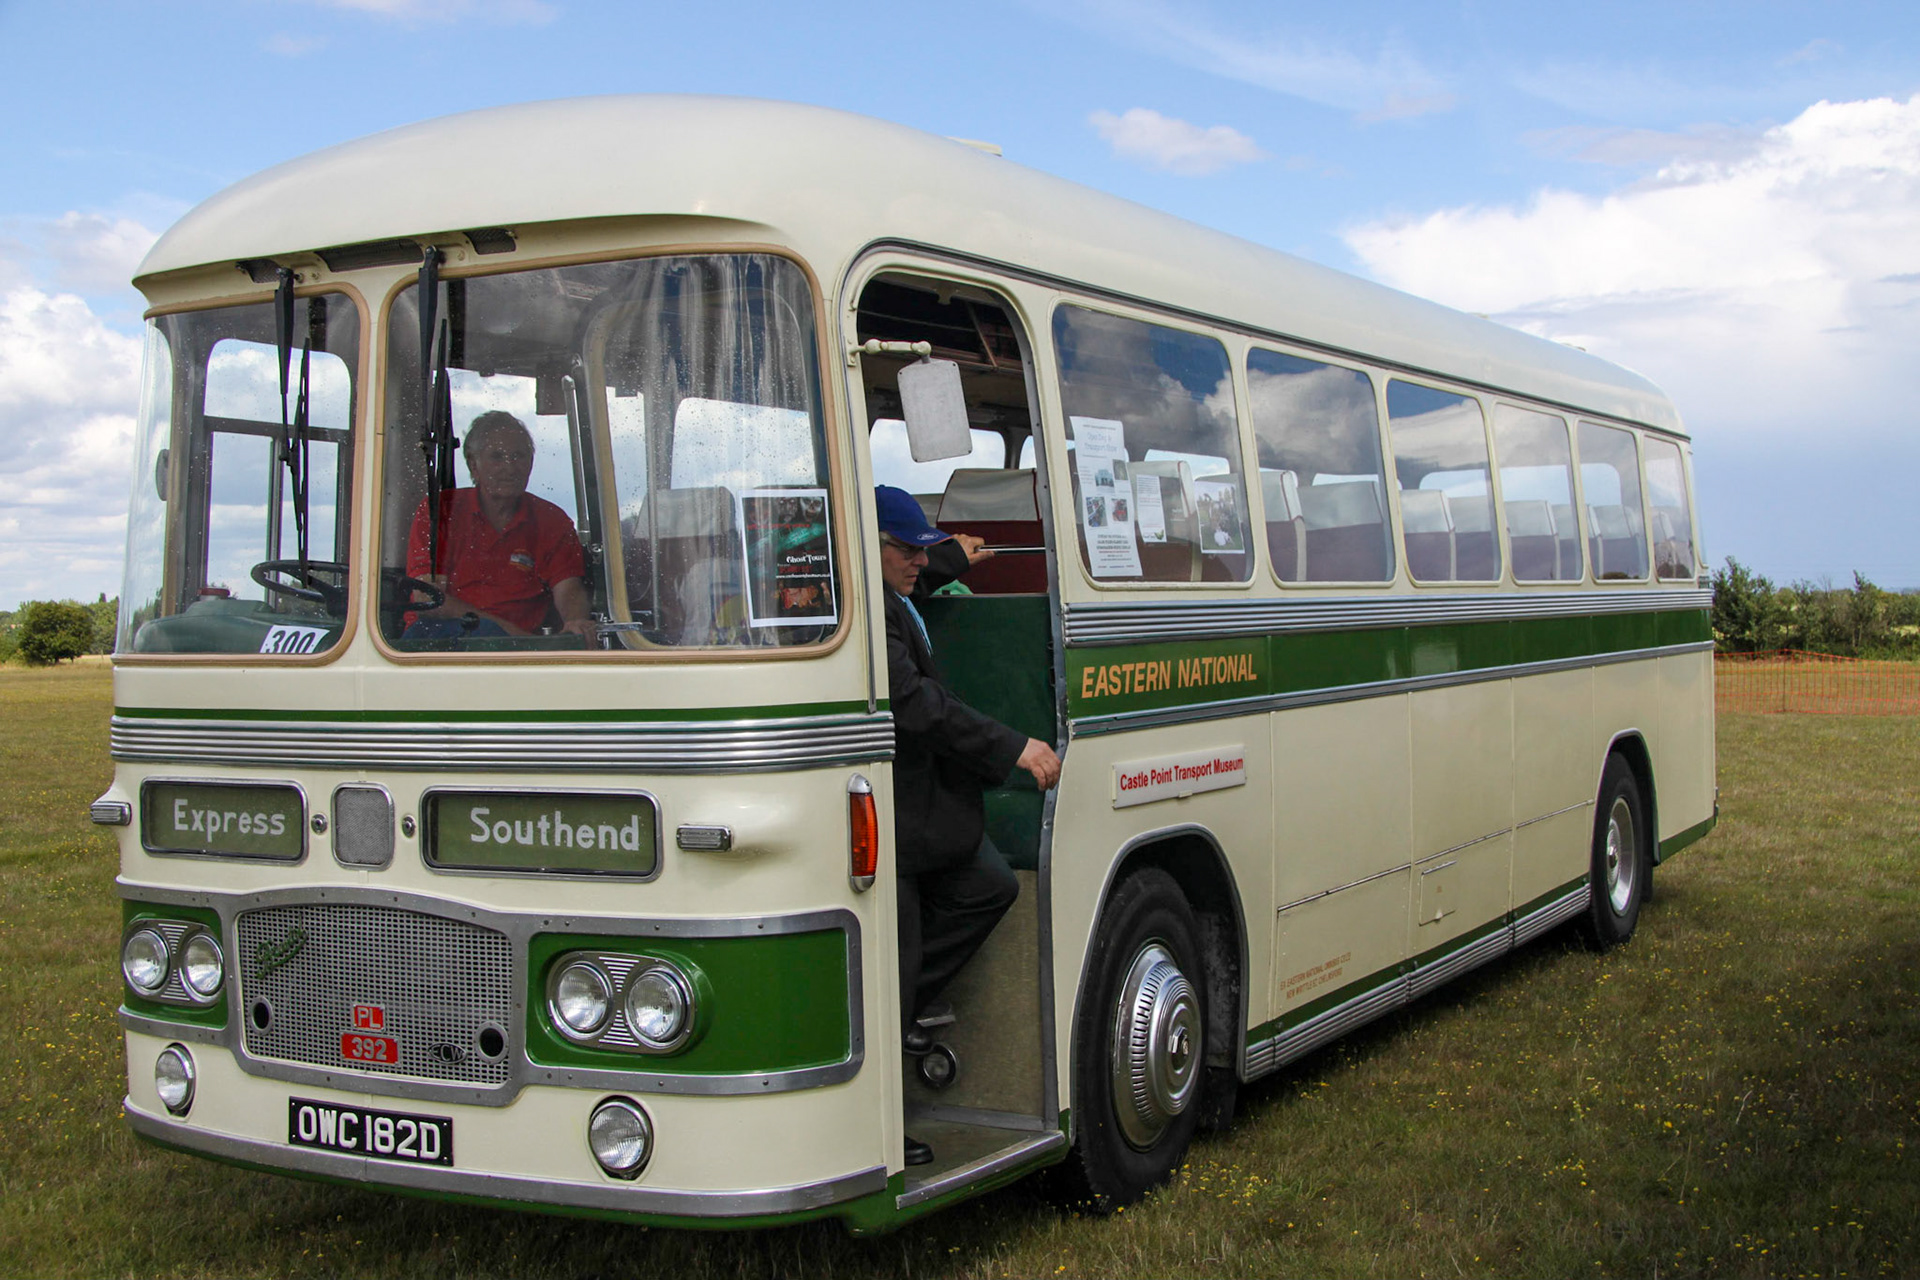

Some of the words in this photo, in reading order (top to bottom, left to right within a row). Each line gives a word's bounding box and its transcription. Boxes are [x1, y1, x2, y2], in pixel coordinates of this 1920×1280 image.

[786, 555, 806, 563] Ghost
[805, 554, 827, 564] Tours
[266, 630, 316, 653] 300
[1081, 660, 1171, 699] EASTERN
[1178, 653, 1257, 688] NATIONAL
[1120, 772, 1149, 791] Castle
[1151, 767, 1172, 786] Point
[1174, 763, 1212, 784] Transport
[1213, 757, 1244, 774] Museum
[173, 798, 286, 842] Express
[470, 808, 640, 852] Southend
[357, 1006, 382, 1028] PL
[351, 1036, 388, 1061] 392
[431, 1044, 463, 1061] ECW
[299, 1105, 358, 1149] OWC
[364, 1115, 441, 1160] 182D
